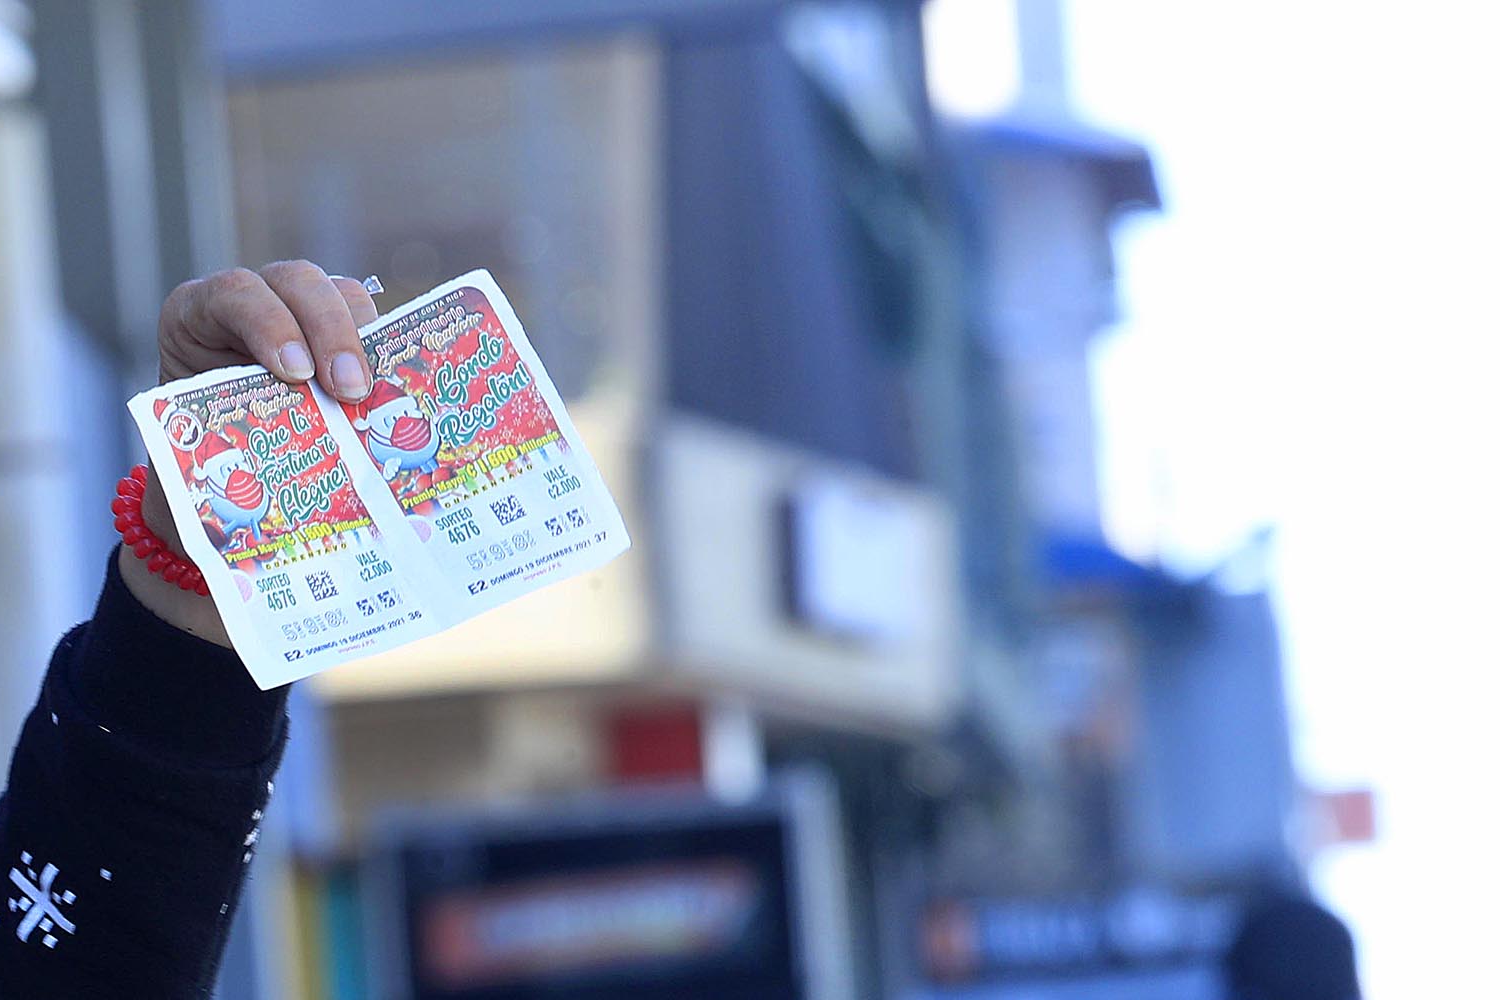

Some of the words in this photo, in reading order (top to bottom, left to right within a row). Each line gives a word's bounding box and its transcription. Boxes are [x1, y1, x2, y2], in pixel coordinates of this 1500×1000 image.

[440, 362, 531, 448] Regalón!
[290, 410, 309, 430] la
[256, 447, 322, 496] Fortuna
[320, 434, 337, 455] te
[543, 464, 569, 484] VALE
[279, 460, 349, 525] Llegue!
[402, 486, 437, 511] Premio
[436, 472, 468, 495] Mayor
[435, 506, 473, 531] SORTEO
[448, 519, 481, 545] 4676
[225, 547, 258, 564] Premio
[258, 538, 285, 559] Mayor
[355, 550, 380, 567] VALE
[467, 579, 489, 596] E2
[490, 567, 524, 586] DOMINGO
[525, 562, 535, 573] 19
[535, 546, 573, 567] DICIEMBRE
[575, 540, 593, 552] 2021
[594, 531, 608, 544] 37
[256, 572, 291, 593] SORTEO
[266, 588, 297, 612] 4676
[284, 648, 304, 662] E2
[305, 640, 338, 656] DOMINGO
[338, 636, 348, 647] 19
[348, 624, 386, 643] DICIEMBRE
[388, 617, 405, 630] 2021
[407, 610, 422, 622] 36
